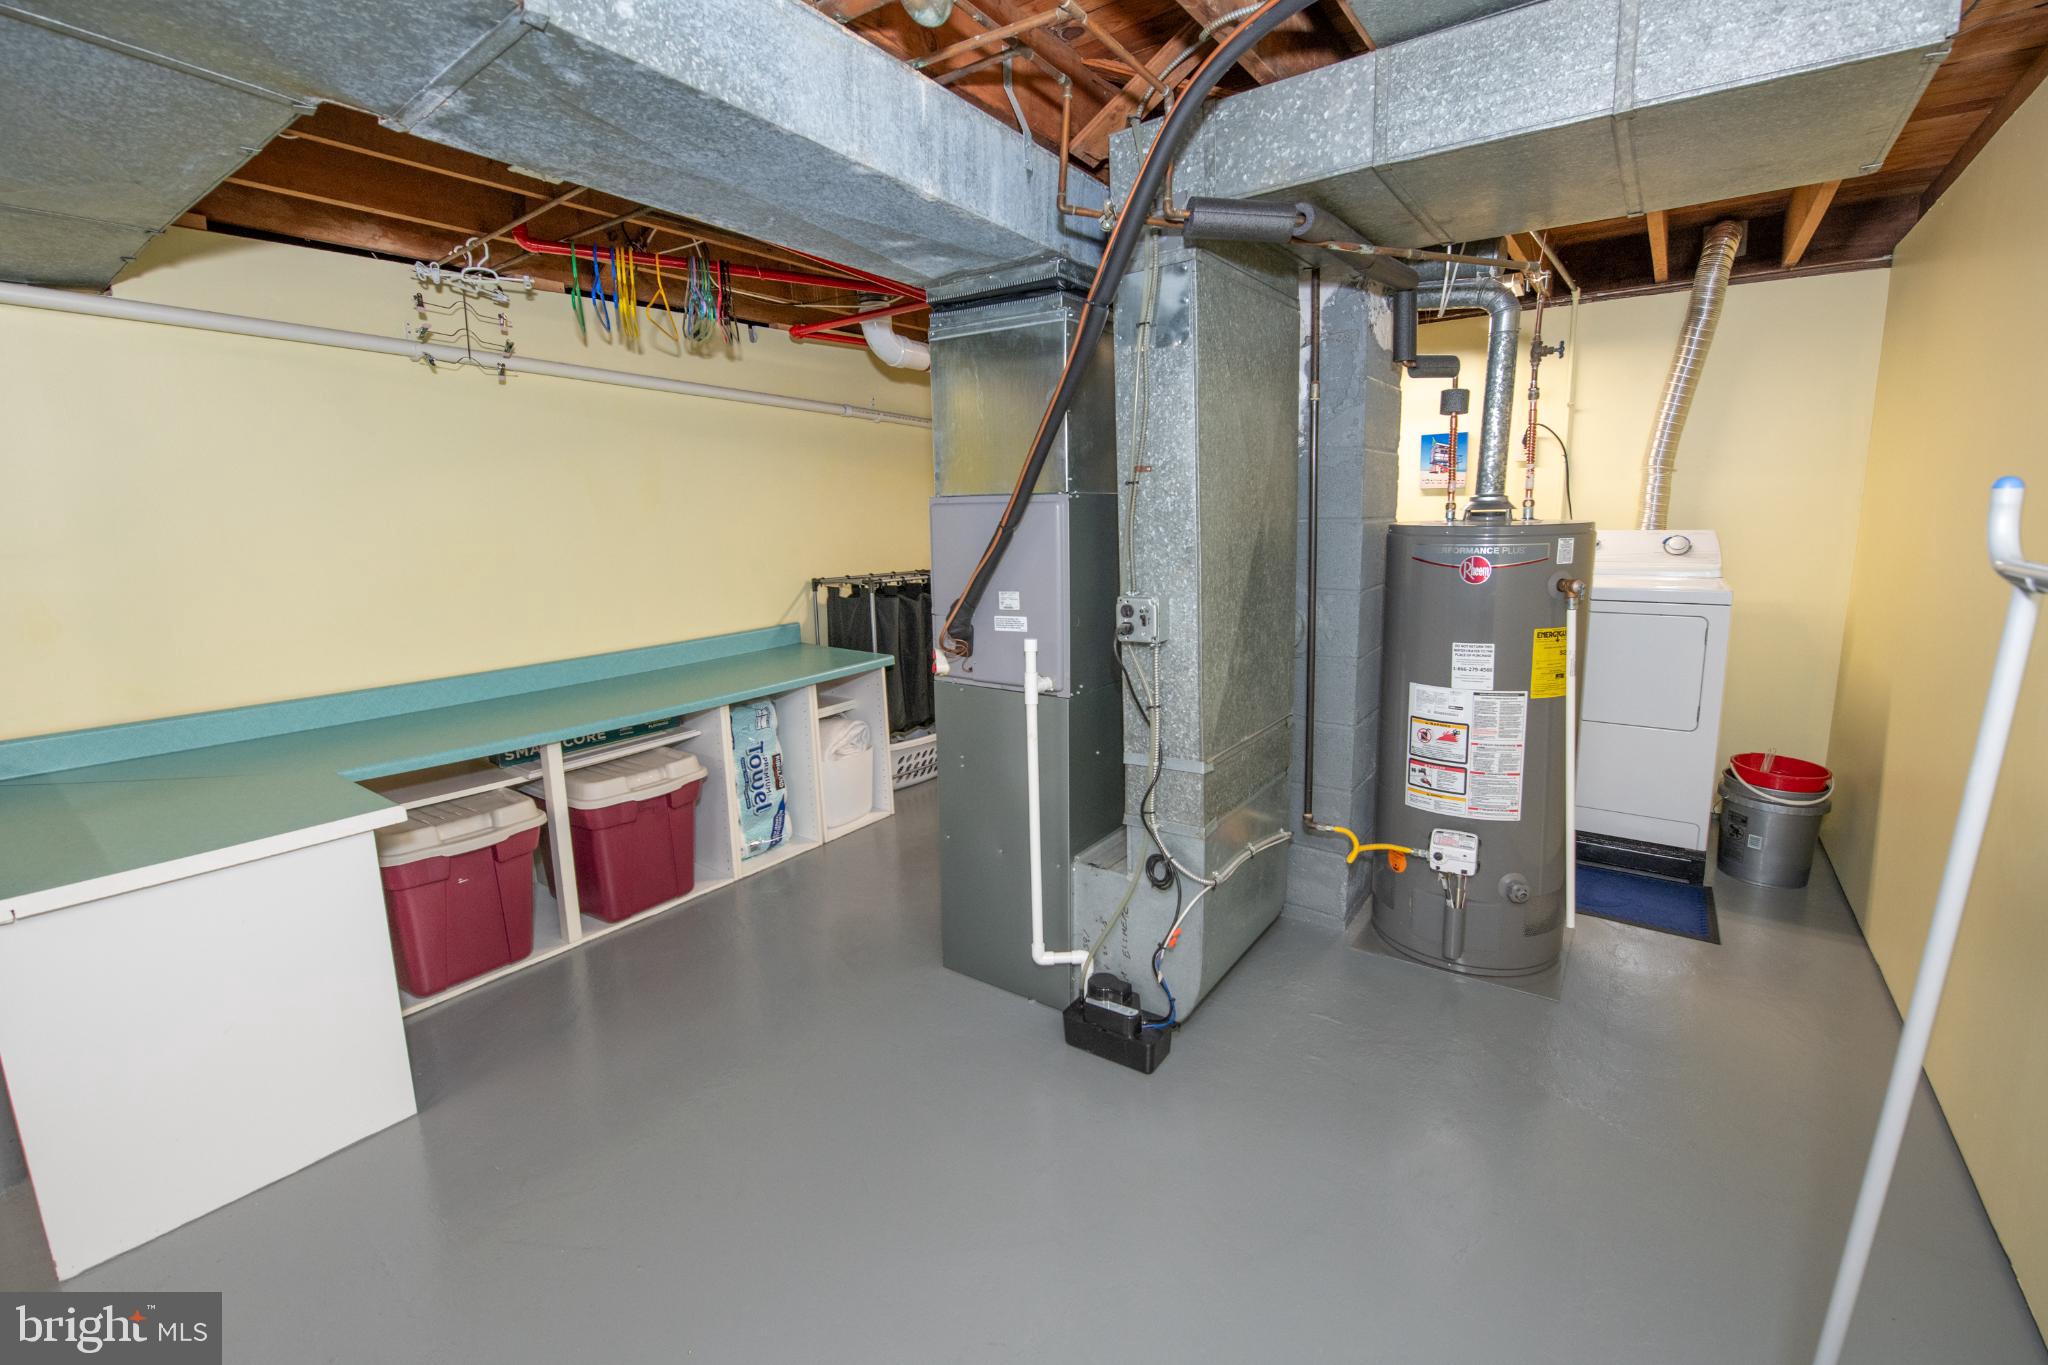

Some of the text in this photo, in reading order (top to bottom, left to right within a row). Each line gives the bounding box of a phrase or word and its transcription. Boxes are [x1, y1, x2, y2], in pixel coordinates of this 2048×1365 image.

[1462, 556, 1490, 580] Rheem
[749, 740, 772, 814] Towel
[763, 756, 772, 794] PREMIUM
